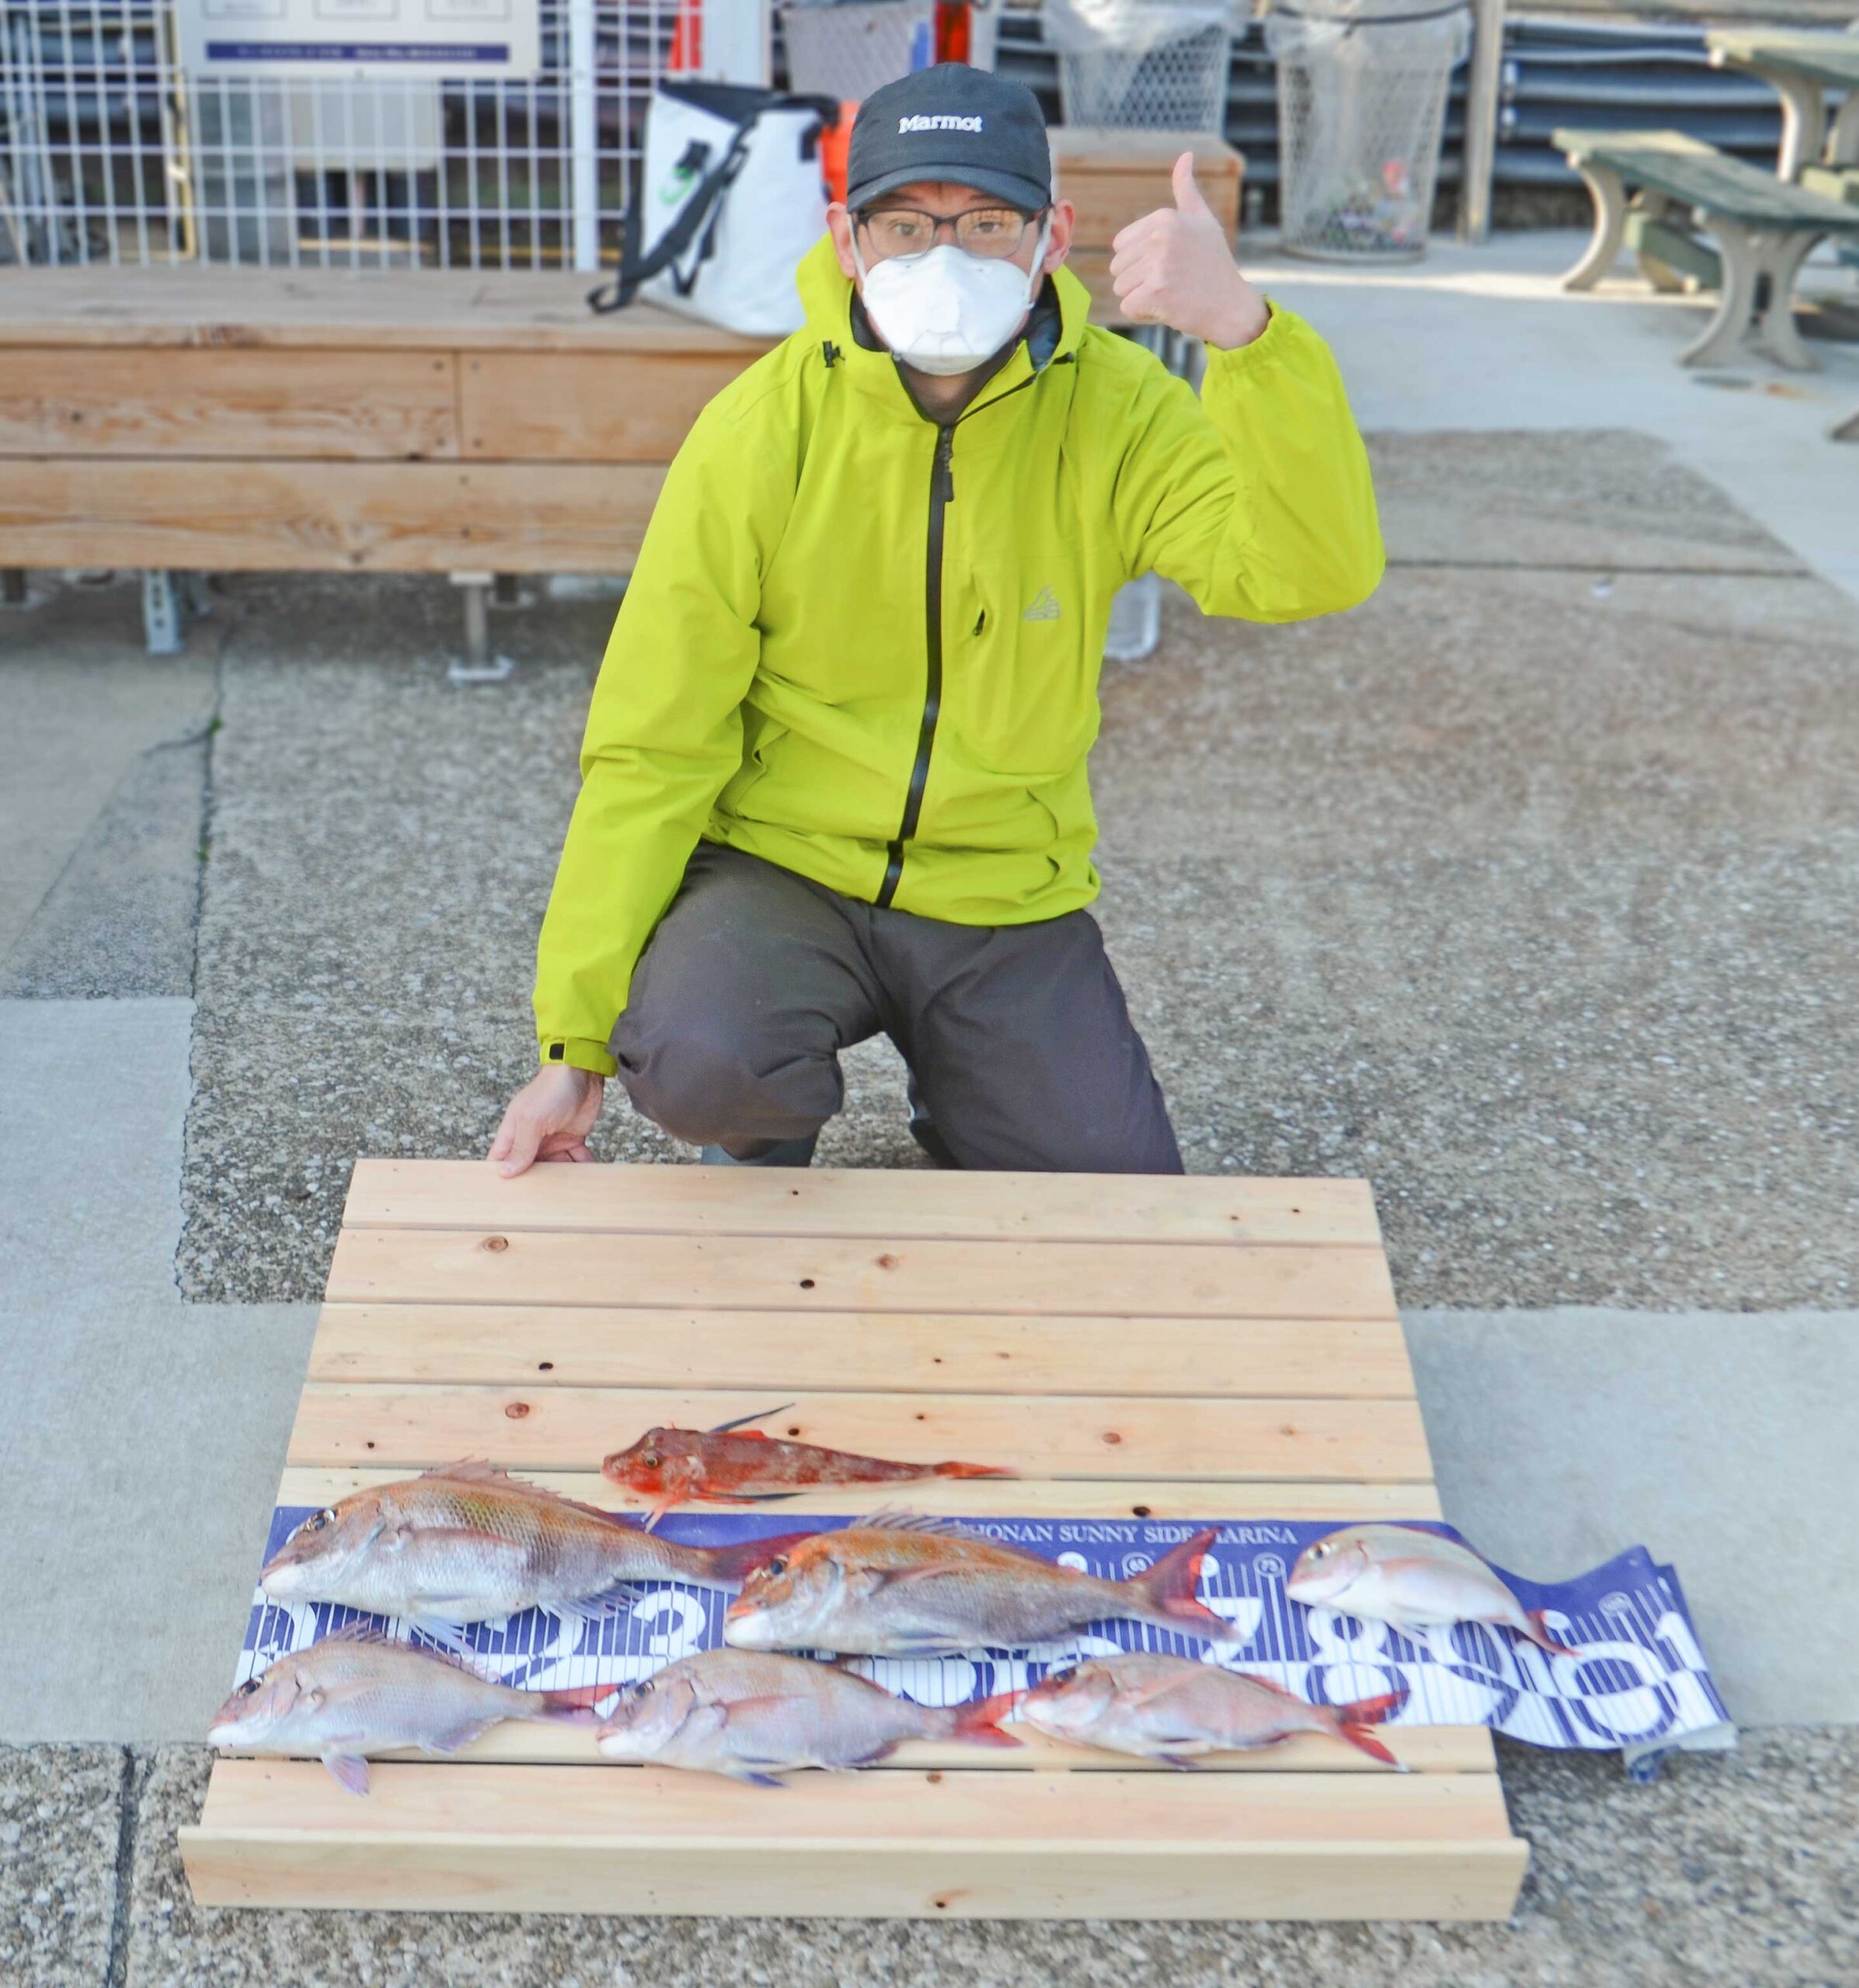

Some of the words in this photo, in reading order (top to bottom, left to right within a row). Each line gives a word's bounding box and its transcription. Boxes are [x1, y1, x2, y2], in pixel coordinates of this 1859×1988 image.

[898, 114, 982, 134] Marmot
[1058, 1524, 1138, 1543] SUNNY
[1206, 1527, 1298, 1545] ARINA
